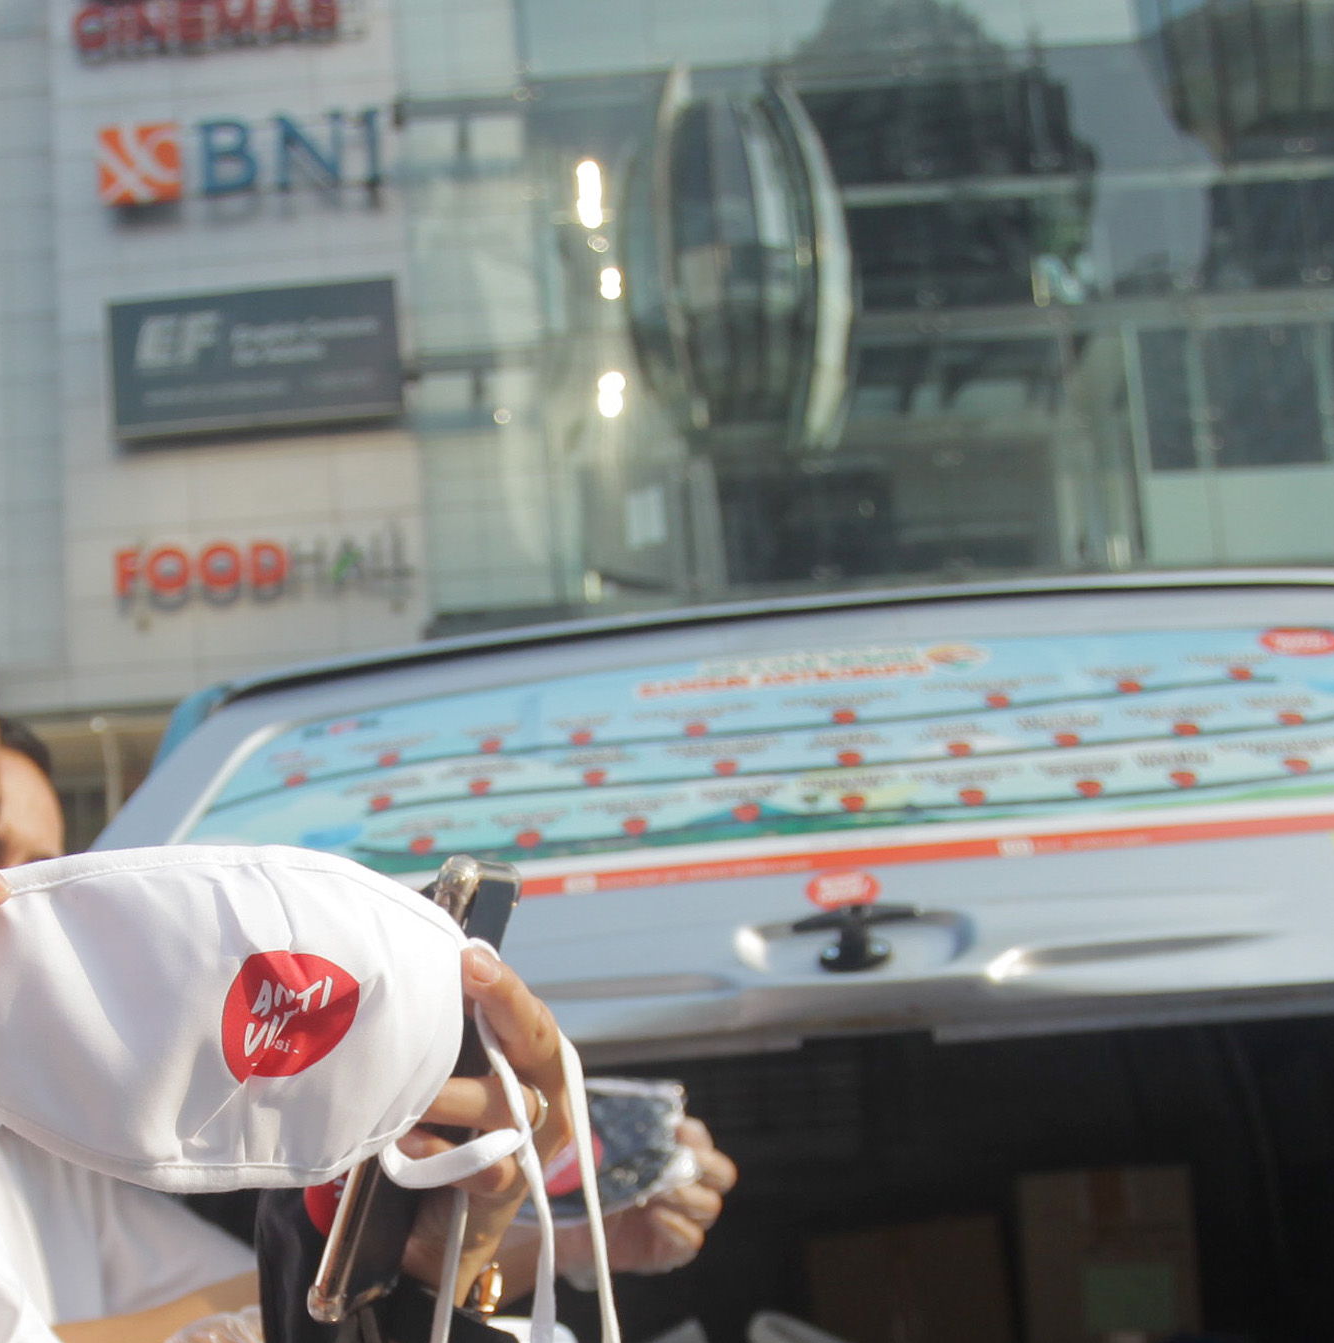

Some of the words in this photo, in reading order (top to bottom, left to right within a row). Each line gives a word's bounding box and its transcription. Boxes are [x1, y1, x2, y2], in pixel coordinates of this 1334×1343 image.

[198, 109, 382, 196] BNI
[135, 311, 221, 367] EF
[250, 974, 334, 1019] ANTI
